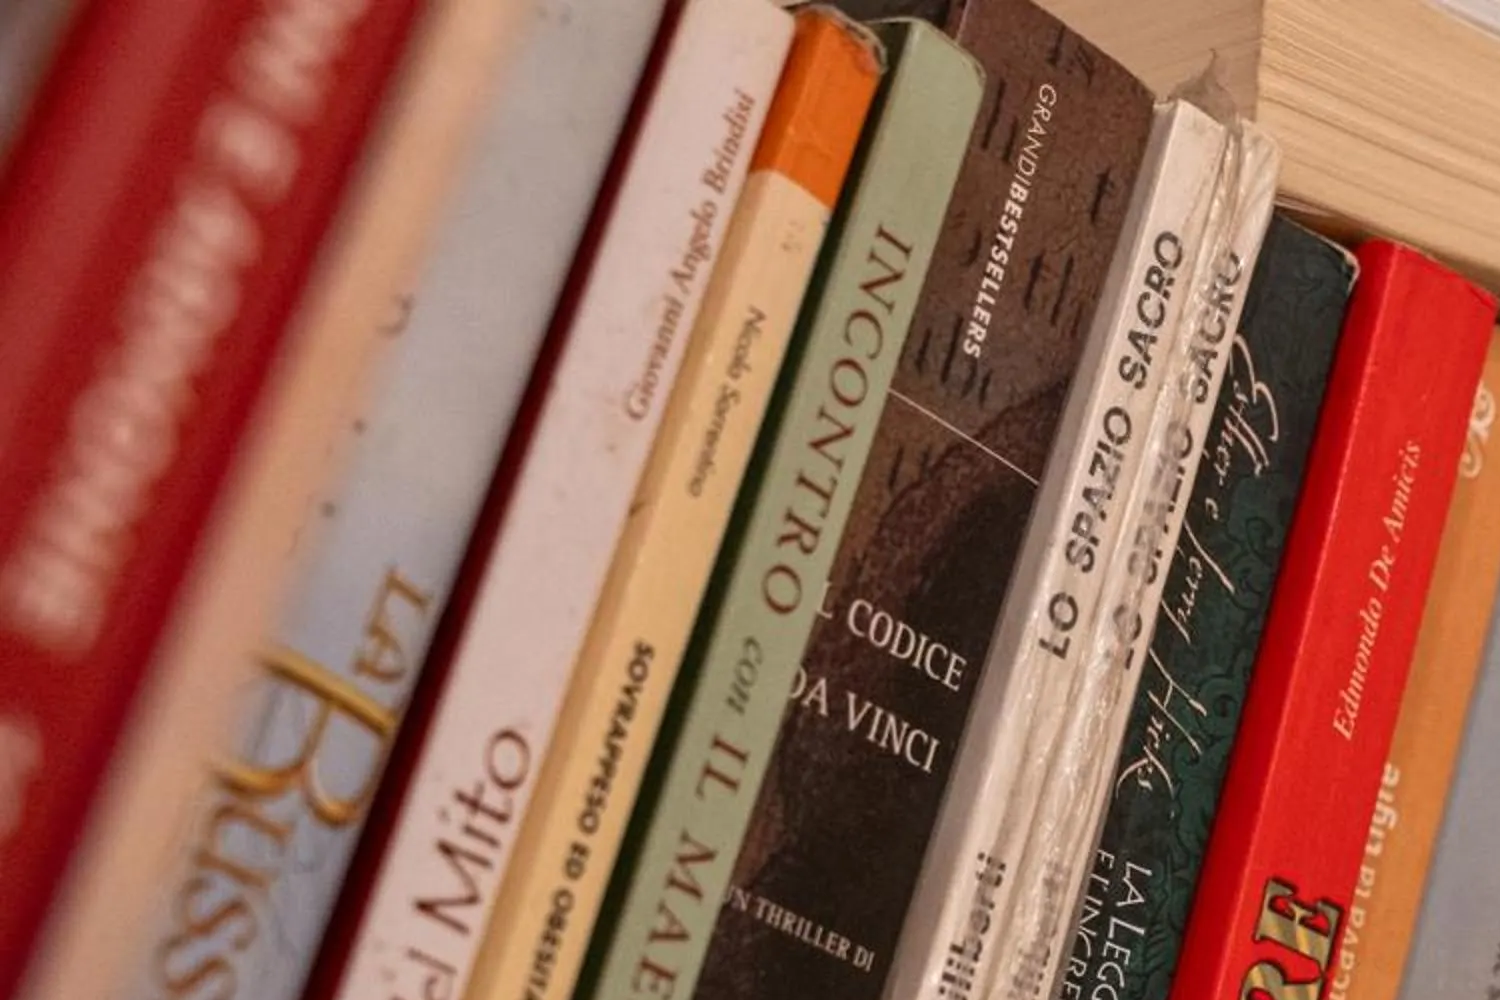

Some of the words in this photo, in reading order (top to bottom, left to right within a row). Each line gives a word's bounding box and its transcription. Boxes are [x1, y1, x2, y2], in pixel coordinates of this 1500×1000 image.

[625, 293, 688, 422] Giovanni
[675, 194, 719, 290] Angelo
[705, 90, 756, 193] Brindisi
[761, 221, 912, 616] INCONTRO
[1037, 590, 1080, 661] LO
[1062, 403, 1134, 575] SPAZIO
[1117, 229, 1185, 391] SACRO
[1384, 440, 1421, 540] Amicis
[1373, 548, 1397, 596] De
[727, 636, 764, 715] con
[847, 598, 968, 692] CODICE
[1332, 594, 1386, 742] Edmondo
[581, 641, 653, 835] SOVRAPPESO
[703, 731, 750, 801] IL
[846, 689, 941, 775] VINCI
[413, 726, 531, 937] Mito
[565, 841, 591, 878] ED
[1113, 861, 1152, 906] LA
[754, 895, 850, 961] THRILLER
[851, 948, 874, 974] DI
